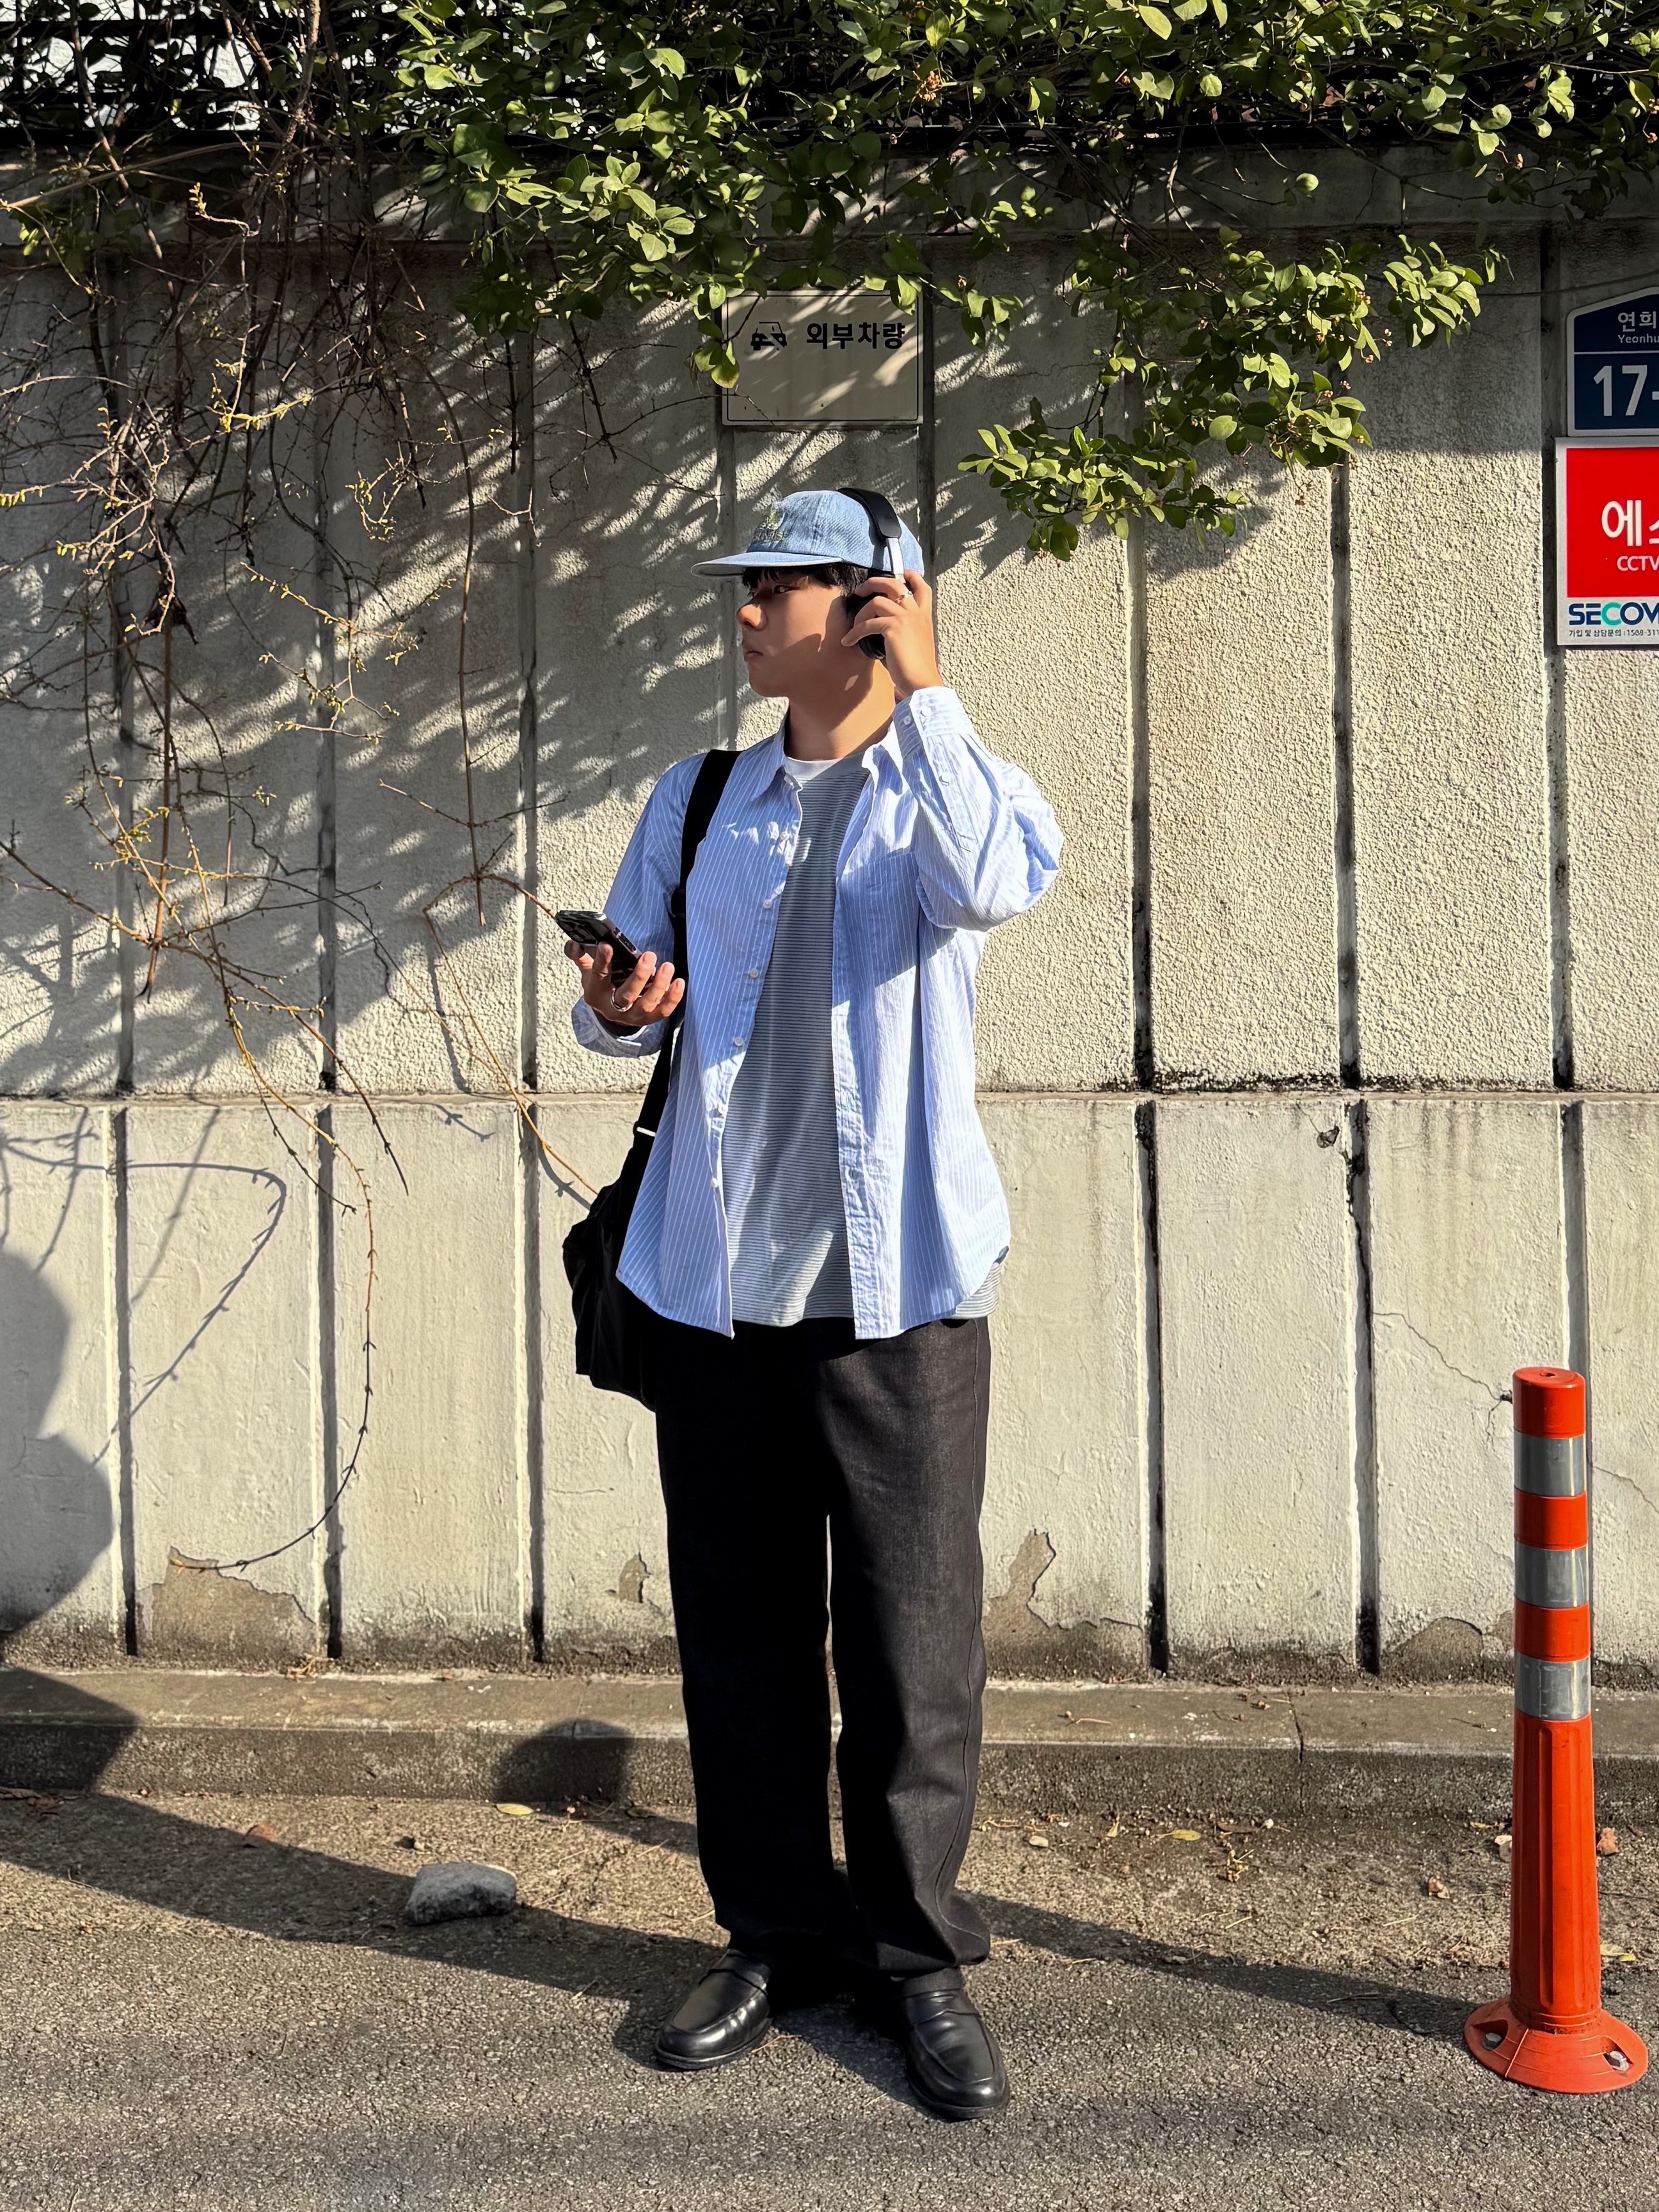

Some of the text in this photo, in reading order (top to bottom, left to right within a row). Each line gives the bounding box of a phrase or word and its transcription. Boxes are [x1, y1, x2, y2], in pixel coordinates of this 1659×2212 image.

[1618, 311, 1656, 332] 연희
[806, 322, 905, 349] 외부차량
[1618, 333, 1659, 344] Yeonhu
[1593, 365, 1659, 416] 17-
[1616, 555, 1659, 571] CCTV
[1569, 629, 1583, 637] 가입
[1585, 629, 1591, 637] 및
[1593, 628, 1621, 637] 상담문의
